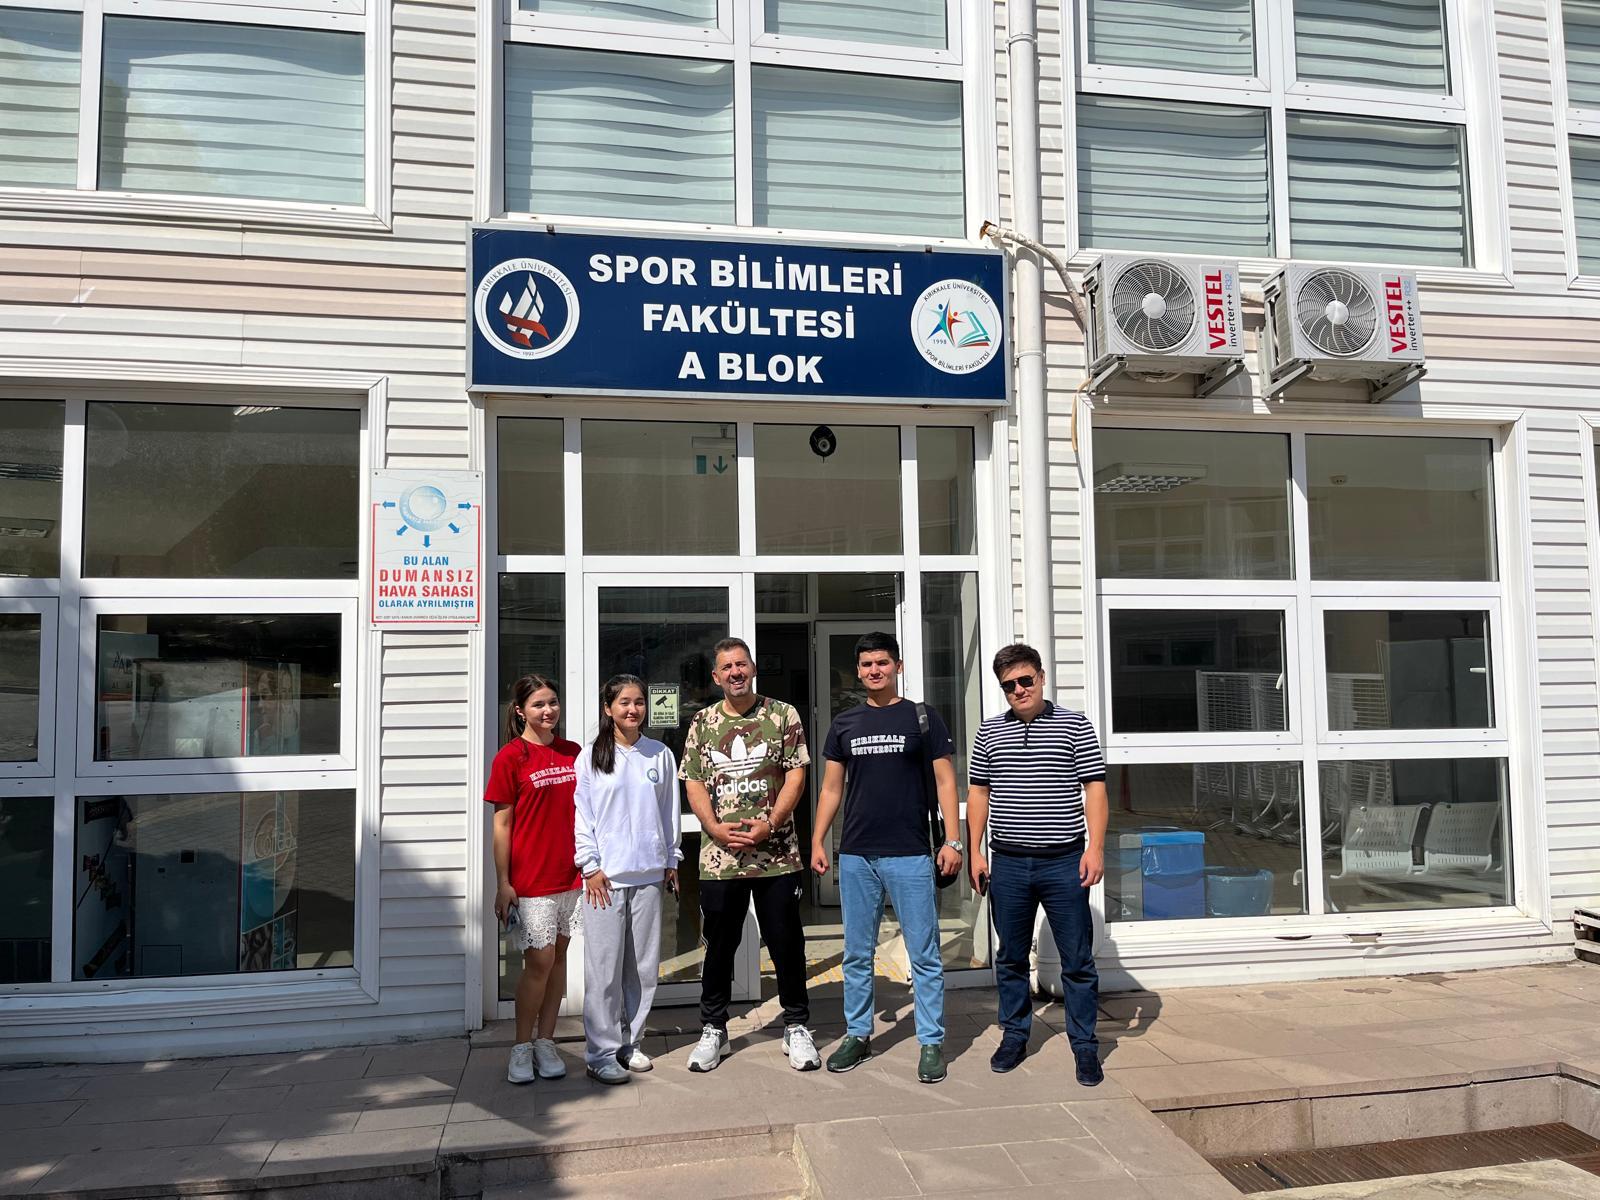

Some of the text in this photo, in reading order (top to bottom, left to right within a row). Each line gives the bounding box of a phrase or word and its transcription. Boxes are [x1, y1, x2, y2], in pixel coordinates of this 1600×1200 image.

[481, 261, 575, 296] KIRIKKALE ÜNİVERSİTESİ
[589, 254, 902, 296] SPOR BİLİMLERİ
[924, 284, 951, 302] KIRIKKALE
[1205, 269, 1227, 350] VESTEL
[1385, 276, 1408, 354] VESTEL
[643, 300, 855, 339] FAKÜLTESİ
[925, 349, 938, 362] SPOR
[678, 351, 824, 384] A BLOK
[404, 556, 449, 566] BU ALAN
[379, 569, 474, 583] DUMANSIZ
[379, 585, 474, 597] HAVA SAHASI
[378, 600, 474, 609] OLARAK AYRILMIŞTIR
[851, 735, 906, 748] KIRIKKALE
[851, 744, 905, 756] UNIVERSITY
[533, 774, 577, 789] UNIVERSIT
[715, 777, 768, 797] adidas
